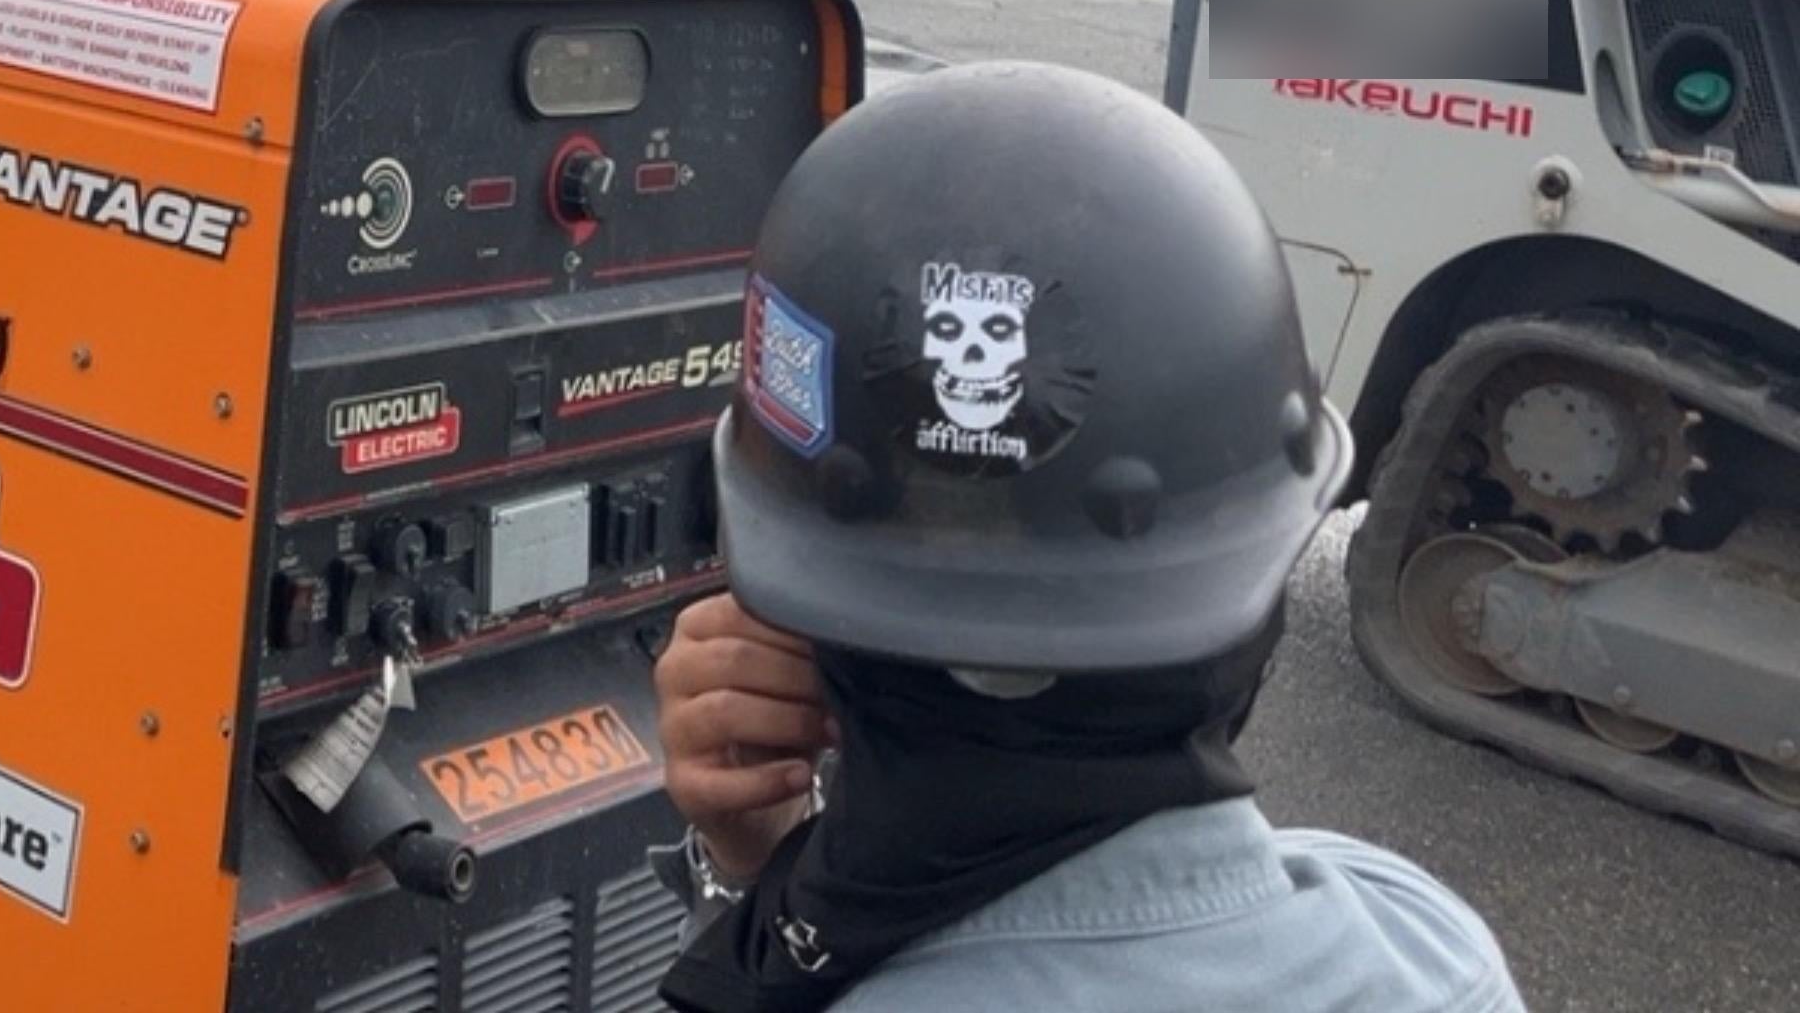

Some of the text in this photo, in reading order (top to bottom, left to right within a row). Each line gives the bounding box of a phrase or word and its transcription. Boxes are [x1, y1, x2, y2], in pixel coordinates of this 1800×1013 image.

[562, 358, 682, 403] VANTAGE
[334, 391, 439, 437] LINCOLN
[358, 425, 448, 463] ELECTRIC
[431, 709, 643, 813] 254830
